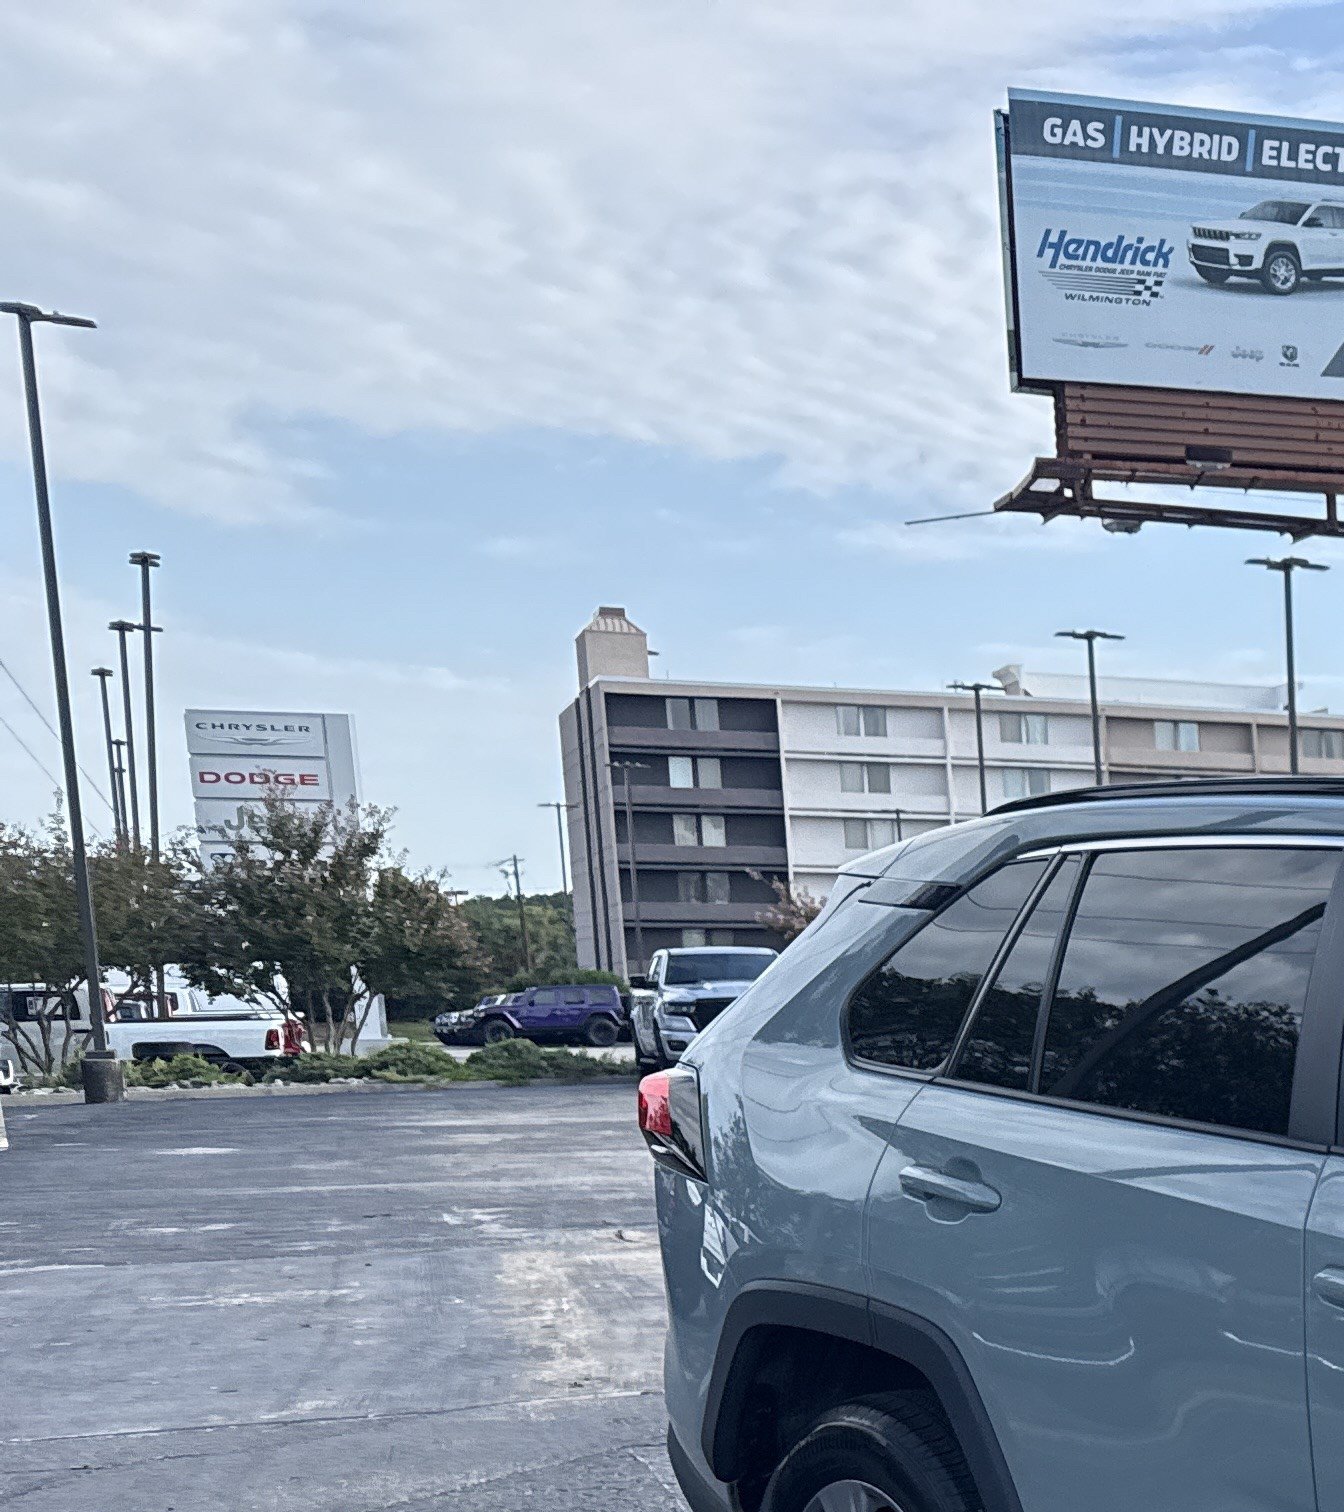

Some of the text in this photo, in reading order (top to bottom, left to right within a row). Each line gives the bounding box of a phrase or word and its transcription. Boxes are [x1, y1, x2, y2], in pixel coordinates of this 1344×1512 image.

[1043, 116, 1106, 149] GAS
[1128, 125, 1240, 162] HYBRID
[1036, 228, 1174, 268] Hendrick
[1065, 293, 1151, 306] WILMINGTON
[195, 722, 311, 733] CHRYSLER
[199, 771, 320, 786] DODGE
